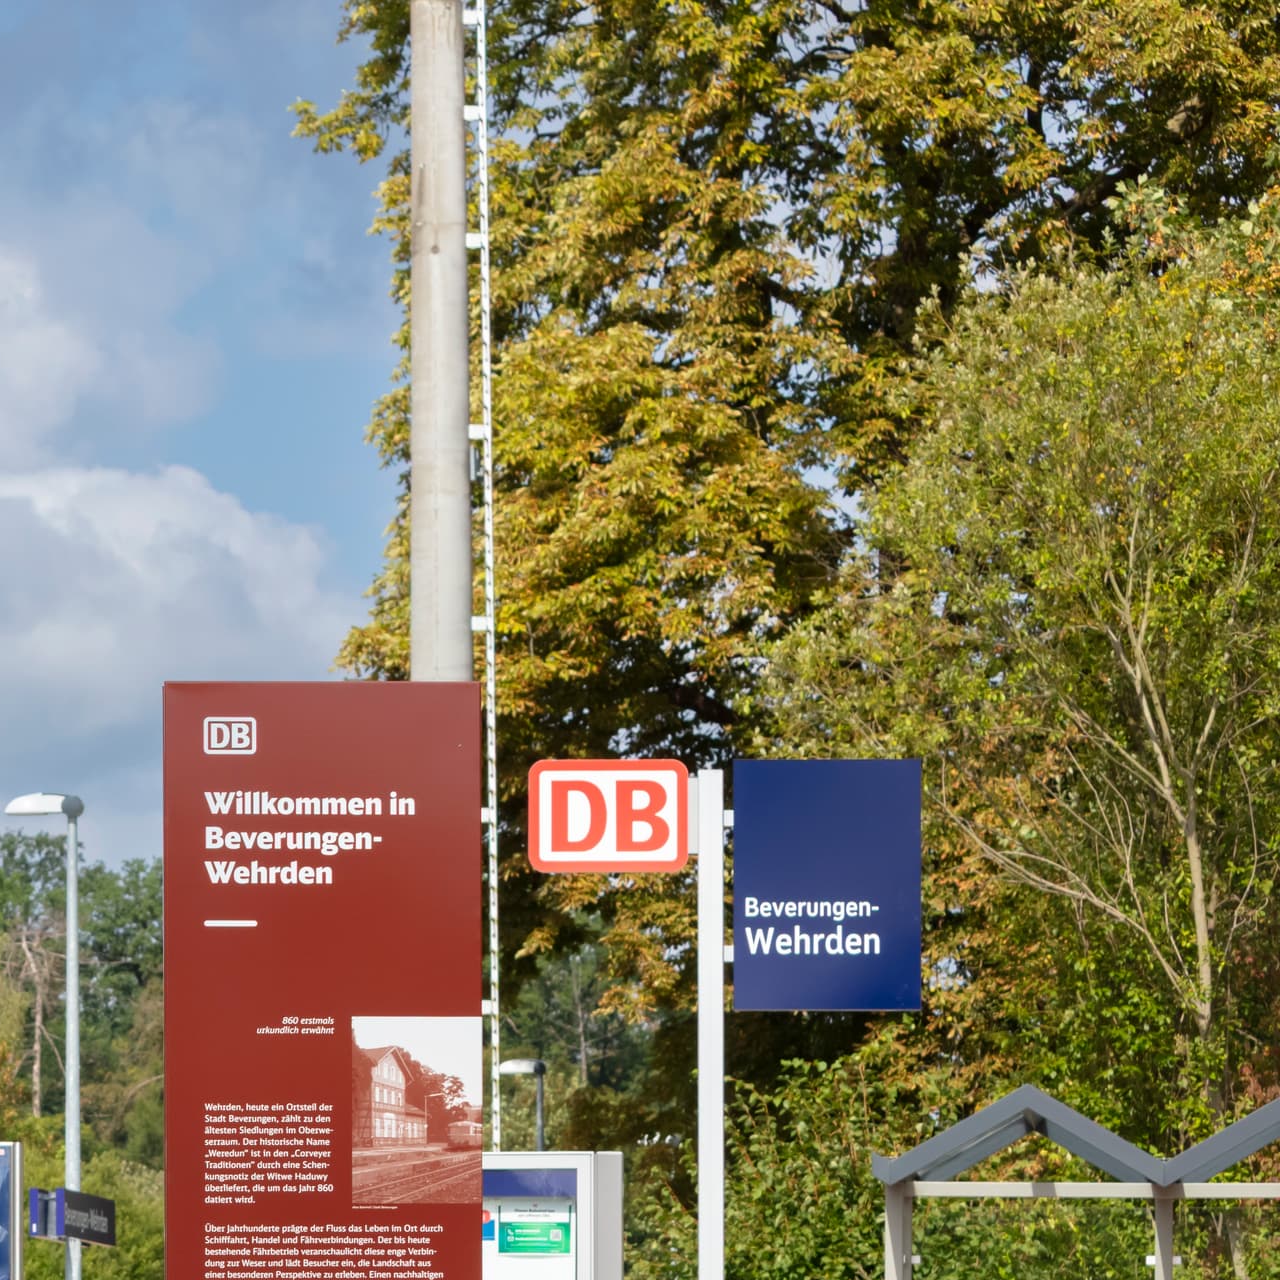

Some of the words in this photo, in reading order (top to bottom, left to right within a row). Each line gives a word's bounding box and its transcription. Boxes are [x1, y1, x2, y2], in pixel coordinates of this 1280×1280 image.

[210, 723, 250, 749] DB
[204, 791, 382, 815] Willkommen
[390, 791, 415, 815] in
[551, 780, 670, 853] DB
[205, 826, 382, 855] Beverungen-
[204, 861, 332, 884] Wehrden
[744, 896, 879, 921] Beverungen-
[745, 924, 881, 956] Wehrden
[282, 1017, 298, 1025] 860
[301, 1017, 335, 1025] erstmals
[256, 1026, 299, 1034] urkundlich
[301, 1026, 335, 1034] erwähnt
[204, 1103, 243, 1113] Wehrden,
[246, 1103, 269, 1112] heute
[271, 1103, 284, 1112] ein
[286, 1103, 316, 1112] Ortsteil
[319, 1103, 333, 1112] der
[204, 1115, 226, 1123] Stadt
[229, 1115, 278, 1125] Beverungen,
[281, 1115, 301, 1123] zählt
[315, 1115, 331, 1123] den
[204, 1126, 236, 1135] ältesten
[240, 1126, 283, 1136] Siedlungen
[299, 1126, 334, 1135] Oberwe-
[243, 1138, 257, 1146] Der
[260, 1138, 303, 1146] historische
[306, 1138, 330, 1146] Name
[251, 1149, 260, 1158] ist
[273, 1149, 288, 1158] den
[257, 1161, 280, 1169] durch
[283, 1161, 300, 1169] eine
[303, 1161, 330, 1169] Schen-
[205, 1173, 248, 1183] kungsnotiz
[251, 1173, 264, 1181] der
[267, 1173, 292, 1181] Witwe
[295, 1173, 328, 1183] Haduwy
[205, 1184, 250, 1194] überliefert,
[253, 1184, 265, 1193] die
[283, 1184, 296, 1193] das
[299, 1184, 315, 1193] Jahr
[318, 1184, 334, 1193] 860
[204, 1196, 232, 1204] datiert
[235, 1196, 256, 1204] wird.
[205, 1224, 225, 1233] Über
[227, 1224, 279, 1233] Jahrhunderte
[282, 1224, 308, 1234] prägte
[310, 1224, 324, 1233] der
[326, 1224, 346, 1233] Fluss
[348, 1224, 362, 1233] das
[365, 1224, 389, 1233] Leben
[404, 1224, 417, 1233] Ort
[420, 1224, 443, 1233] durch
[205, 1236, 249, 1246] Schifffahrt,
[252, 1236, 280, 1244] Handel
[283, 1236, 297, 1244] und
[301, 1236, 375, 1246] Fährverbindungen.
[378, 1236, 392, 1244] Der
[394, 1236, 405, 1244] bis
[408, 1236, 430, 1244] heute
